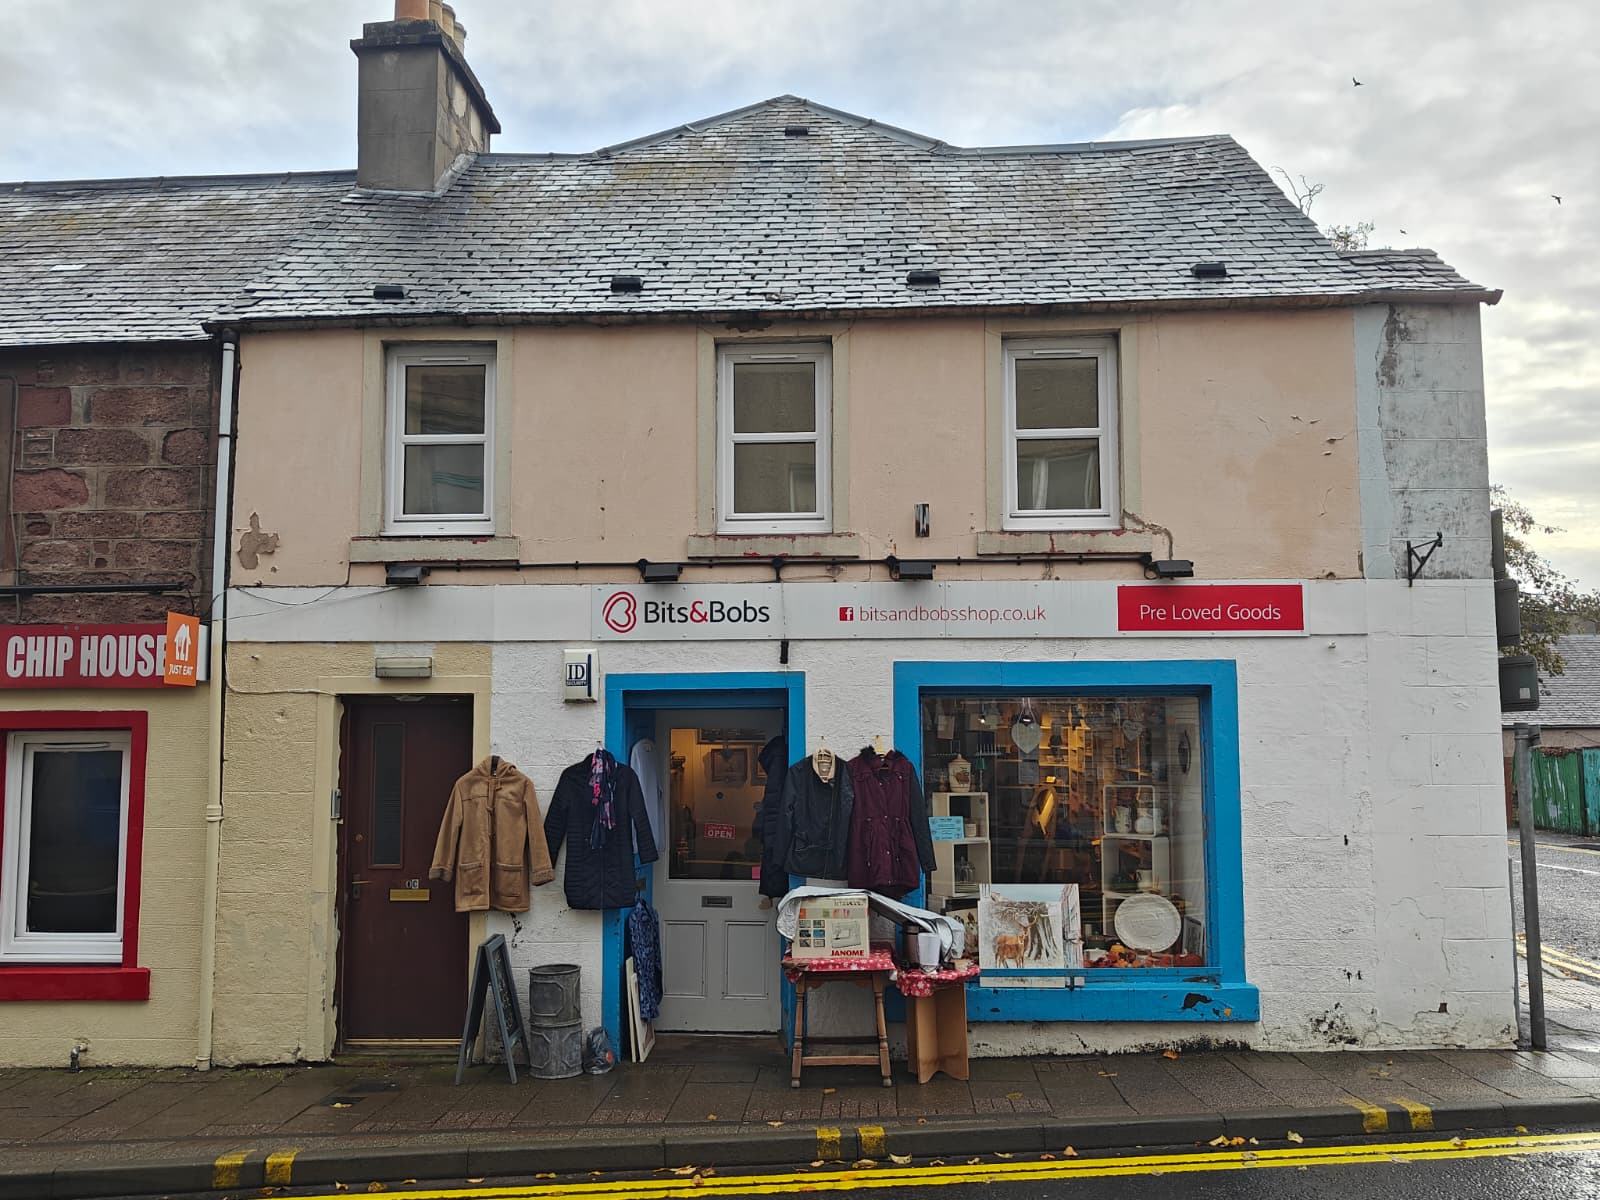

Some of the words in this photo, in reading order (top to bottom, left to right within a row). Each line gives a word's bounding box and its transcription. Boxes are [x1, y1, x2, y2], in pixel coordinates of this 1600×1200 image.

[644, 600, 770, 624] Bits&Bobs
[859, 606, 1047, 624] bitsandbobsshop.co.uk
[1140, 604, 1166, 621] Pre
[1172, 604, 1221, 621] Loved
[1227, 604, 1281, 621] Goods
[6, 635, 74, 678] CHIP
[168, 663, 183, 676] JUST
[182, 665, 194, 676] EAT
[567, 664, 586, 680] ID
[707, 830, 733, 839] OPEN
[831, 949, 865, 957] JANOME
